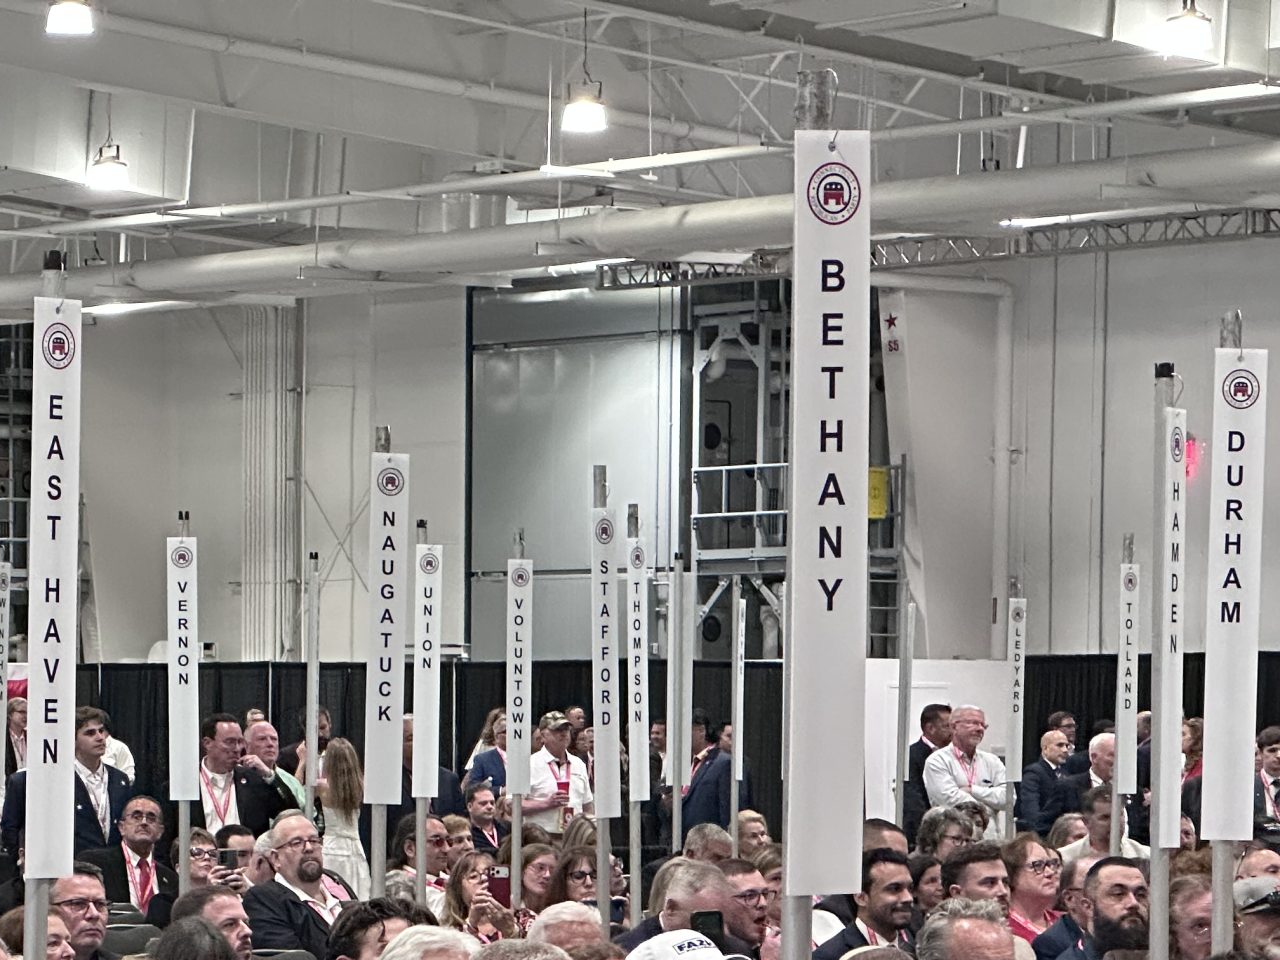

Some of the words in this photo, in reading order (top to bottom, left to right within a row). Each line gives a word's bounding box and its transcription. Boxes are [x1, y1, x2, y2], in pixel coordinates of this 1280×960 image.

[46, 394, 65, 541] EAST
[817, 259, 846, 612] BETHANY
[1170, 481, 1180, 654] HAMDEN
[1220, 430, 1246, 624] DURHAM
[42, 577, 62, 764] HAVEN
[177, 581, 190, 686] VERNON
[378, 510, 396, 722] NAUGATUCK
[422, 586, 433, 669] UNION
[513, 598, 524, 740] VOLUNTOWN
[600, 559, 611, 726] STAFFORD
[633, 581, 642, 723] THOMPSON
[1012, 628, 1021, 713] LEDYARD
[1124, 602, 1133, 710] TOLLAND
